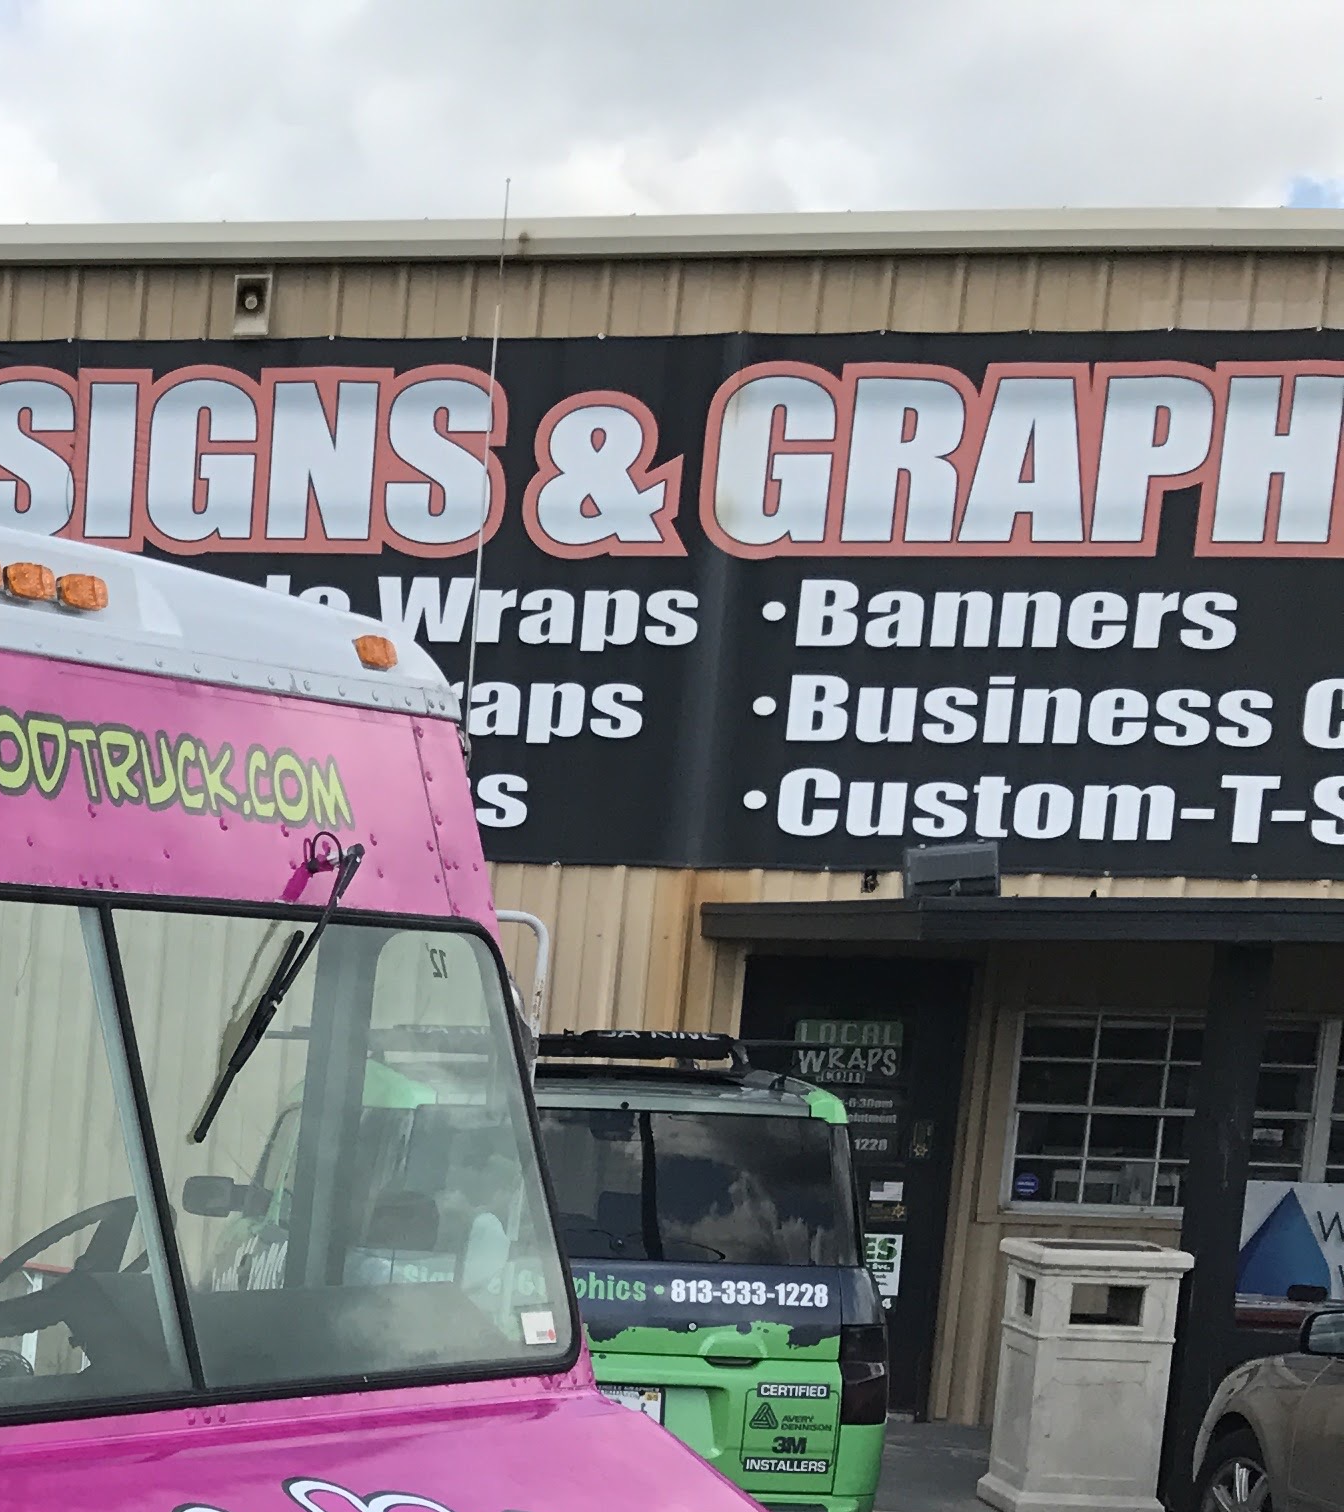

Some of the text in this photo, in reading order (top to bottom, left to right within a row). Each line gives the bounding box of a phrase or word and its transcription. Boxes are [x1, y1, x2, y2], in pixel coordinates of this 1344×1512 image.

[524, 391, 686, 558] &
[702, 362, 1344, 559] GRAPH
[377, 576, 699, 652] Wraps
[795, 579, 1237, 650] Banners
[785, 674, 1274, 748] Business
[799, 1022, 897, 1046] LOCAL
[797, 1048, 897, 1076] WRAPS
[670, 1278, 829, 1308] 813-333-1228
[760, 1384, 827, 1397] CERTIFIED
[781, 1415, 814, 1423] AVERY
[772, 1436, 808, 1454] 3M
[745, 1459, 827, 1473] INSTALLERS
